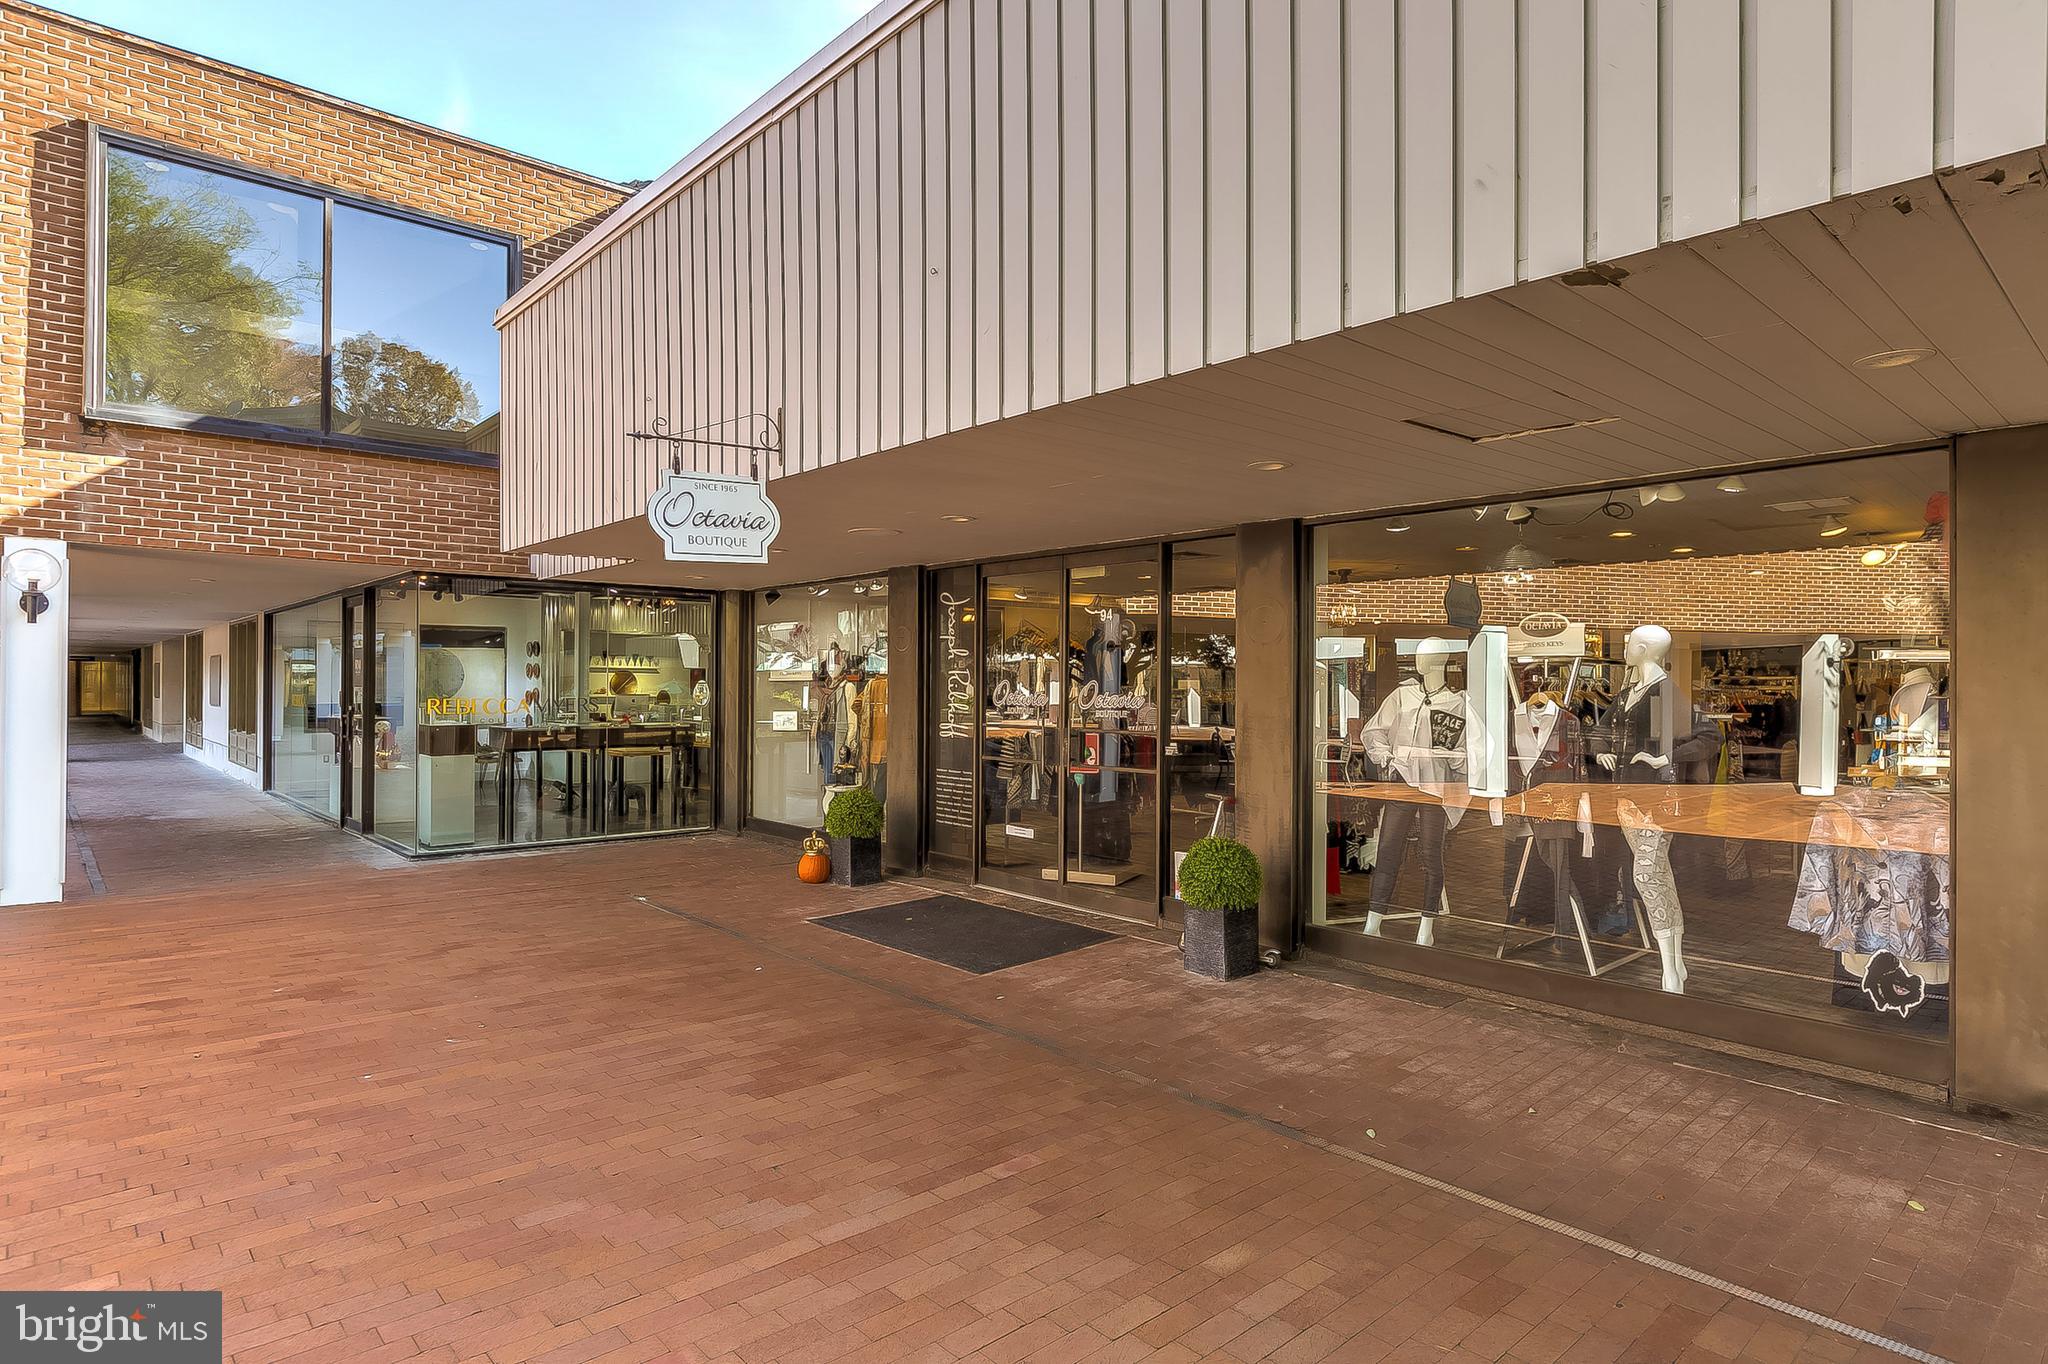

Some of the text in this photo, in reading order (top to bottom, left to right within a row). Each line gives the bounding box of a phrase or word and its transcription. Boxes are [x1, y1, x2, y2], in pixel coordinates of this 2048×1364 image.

[694, 482, 738, 492] SINCE 1965
[662, 491, 770, 530] Octavia
[688, 535, 748, 548] BOUTIQUE
[1100, 608, 1112, 621] 94
[939, 592, 972, 660] Joseph
[1525, 622, 1562, 631] OCTAVIA
[992, 679, 1049, 707] Octavia
[1079, 680, 1146, 710] Octavia
[427, 697, 530, 715] REBECCA
[939, 668, 971, 738] Ribkoff
[1095, 710, 1128, 719] BOUTIQUE
